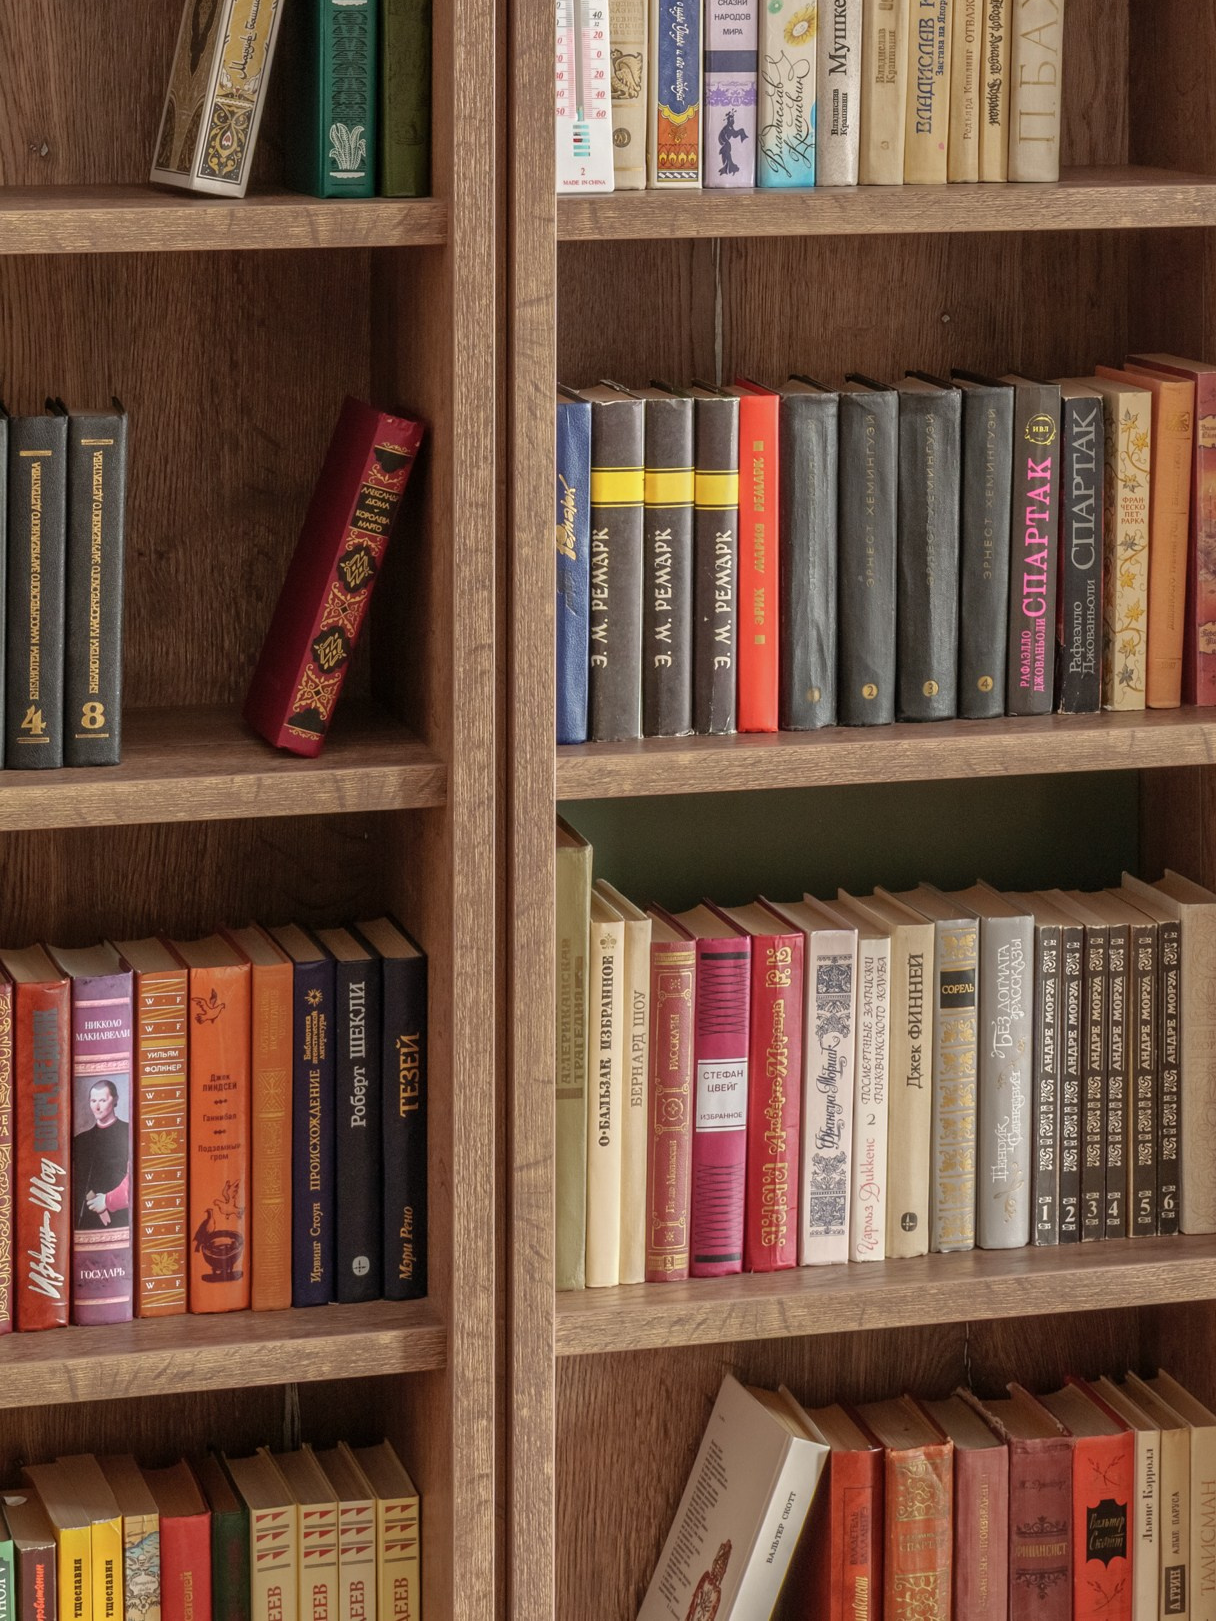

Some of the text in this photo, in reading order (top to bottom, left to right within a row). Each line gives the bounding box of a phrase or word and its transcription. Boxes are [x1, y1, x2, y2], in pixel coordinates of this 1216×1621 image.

[592, 10, 602, 19] 40
[593, 30, 603, 39] 20
[714, 13, 751, 21] НАРОДОВ
[876, 28, 886, 83] Владислав
[916, 18, 935, 134] ВЛАДИСЛАВ
[963, 49, 974, 94] Киплинг
[831, 89, 840, 135] Владислав
[840, 93, 849, 136] Крапивин
[963, 97, 974, 140] Редьярд
[1019, 102, 1056, 144] П.
[864, 414, 876, 588] ЭРНЕСТ ХЕМИНГУЭЙ
[1071, 408, 1097, 570] СПАРТАК
[1122, 517, 1145, 525] РАРКА
[358, 520, 382, 532] МАРГО
[753, 457, 764, 625] ЭРИХ МАРИЯ РЕМАРК
[1022, 457, 1052, 617] СПАРТАК
[591, 527, 609, 668] Э. М. РЕМАРК
[1082, 579, 1096, 674] Джованьоли
[1020, 630, 1031, 687] РАФАЭЛЛО
[1033, 618, 1046, 692] ДЖОВАНЬОЛИ
[1069, 601, 1085, 674] Рафаэлло
[85, 1019, 122, 1029] НИККОЛО
[561, 938, 571, 1084] АМЕРИКАНСКАЯ
[907, 953, 923, 1089] Джек ФИННЕЙ
[942, 984, 974, 993] СОРЕЛЬ
[1090, 976, 1103, 1070] АНДРЕ МОРУА
[76, 1030, 131, 1041] МАКИАВЕЛЛИ
[147, 1050, 179, 1059] УИЛЬЯМ
[349, 981, 367, 1127] Роберт ШЕКЛИ
[575, 990, 584, 1083] ТРАГЕДИЯ
[631, 989, 646, 1107] БЕРНАРД ШОУ
[668, 1014, 680, 1070] РАССКАЗЫ
[860, 956, 874, 1104] ПОСМЕРТНЫЕ ЗАПИСКИ
[874, 956, 888, 1104] ПИКВИКСКОГО КЛУБА
[1044, 978, 1055, 1073] АНДРЕ МОРУА
[1068, 981, 1079, 1075] АНДРЕ МОРУА
[32, 1008, 58, 1151] БОГАЧ, БЕДНЯК
[144, 1063, 181, 1073] ФОЛКНЕР
[396, 1032, 419, 1117] ТЕЗЕЙ
[703, 1069, 744, 1080] СТЕФАН
[707, 1081, 738, 1092] ЦВЕЙГ
[764, 1000, 789, 1154] Альберто Моравиа
[203, 1114, 236, 1122] Ганнибал
[308, 1069, 322, 1191] ПРОИСХОЖДЕНИЕ
[700, 1112, 743, 1121] ИЗБРАННОЕ
[210, 1153, 228, 1162] гром
[28, 1158, 66, 1298] Ирвин Шоу
[309, 1202, 323, 1283] Ирвинг Стоун
[399, 1206, 415, 1279] Мэри Рено
[80, 1267, 125, 1279] ГОСУДАРЬ
[766, 1491, 797, 1564] ВАЛЬТЕР СКОТТ
[1143, 1448, 1156, 1543] Льюис Кэрролл
[1172, 1491, 1180, 1555] АЛЫЕ ПАРУСА
[1200, 1480, 1216, 1596] ТАЛИСМАН
